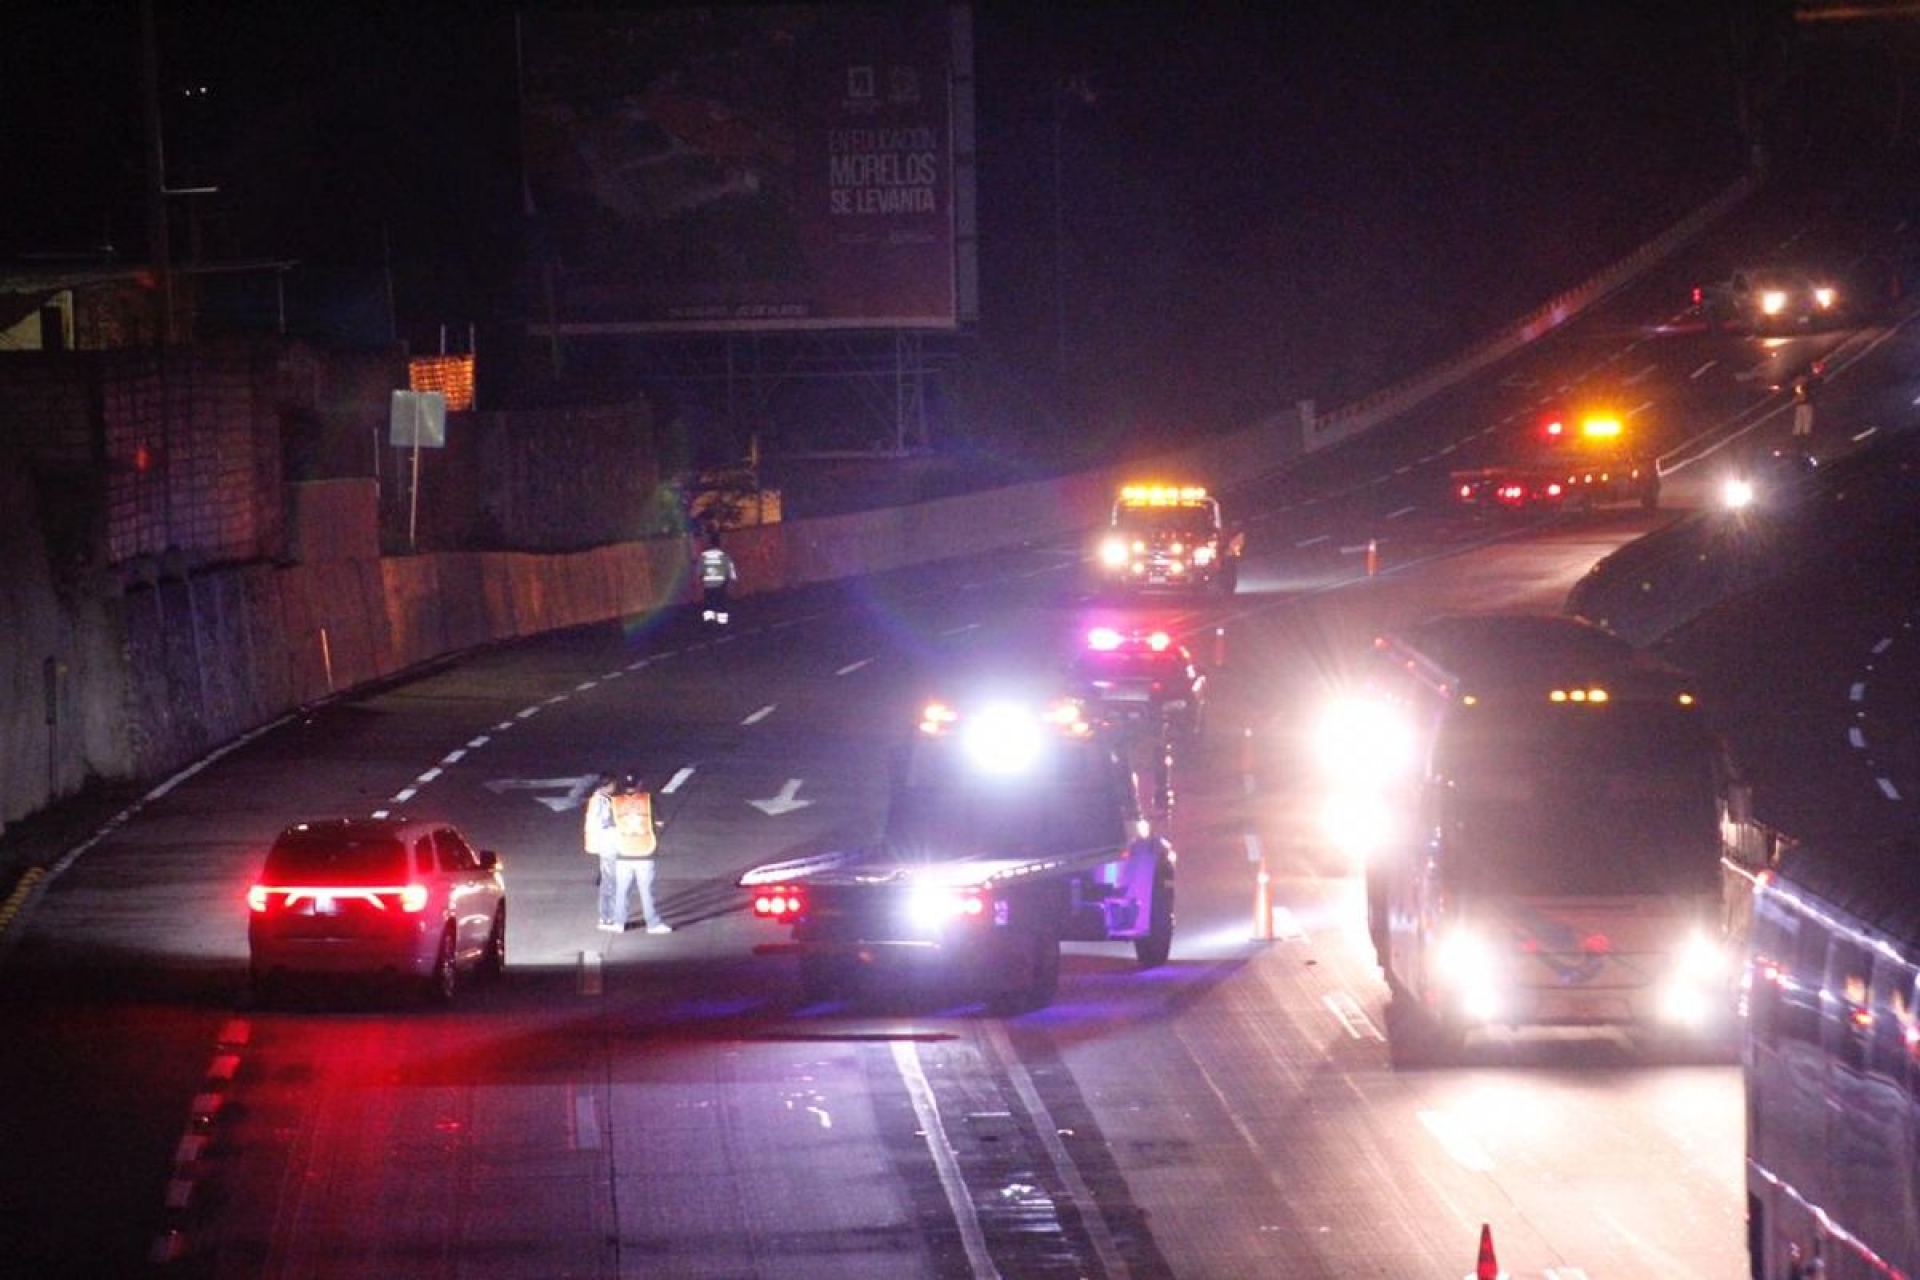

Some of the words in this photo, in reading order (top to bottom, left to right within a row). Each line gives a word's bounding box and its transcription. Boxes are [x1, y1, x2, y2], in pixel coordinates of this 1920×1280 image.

[830, 152, 936, 187] MORELOS
[830, 188, 852, 214] SE
[856, 187, 936, 213] LEVANTA
